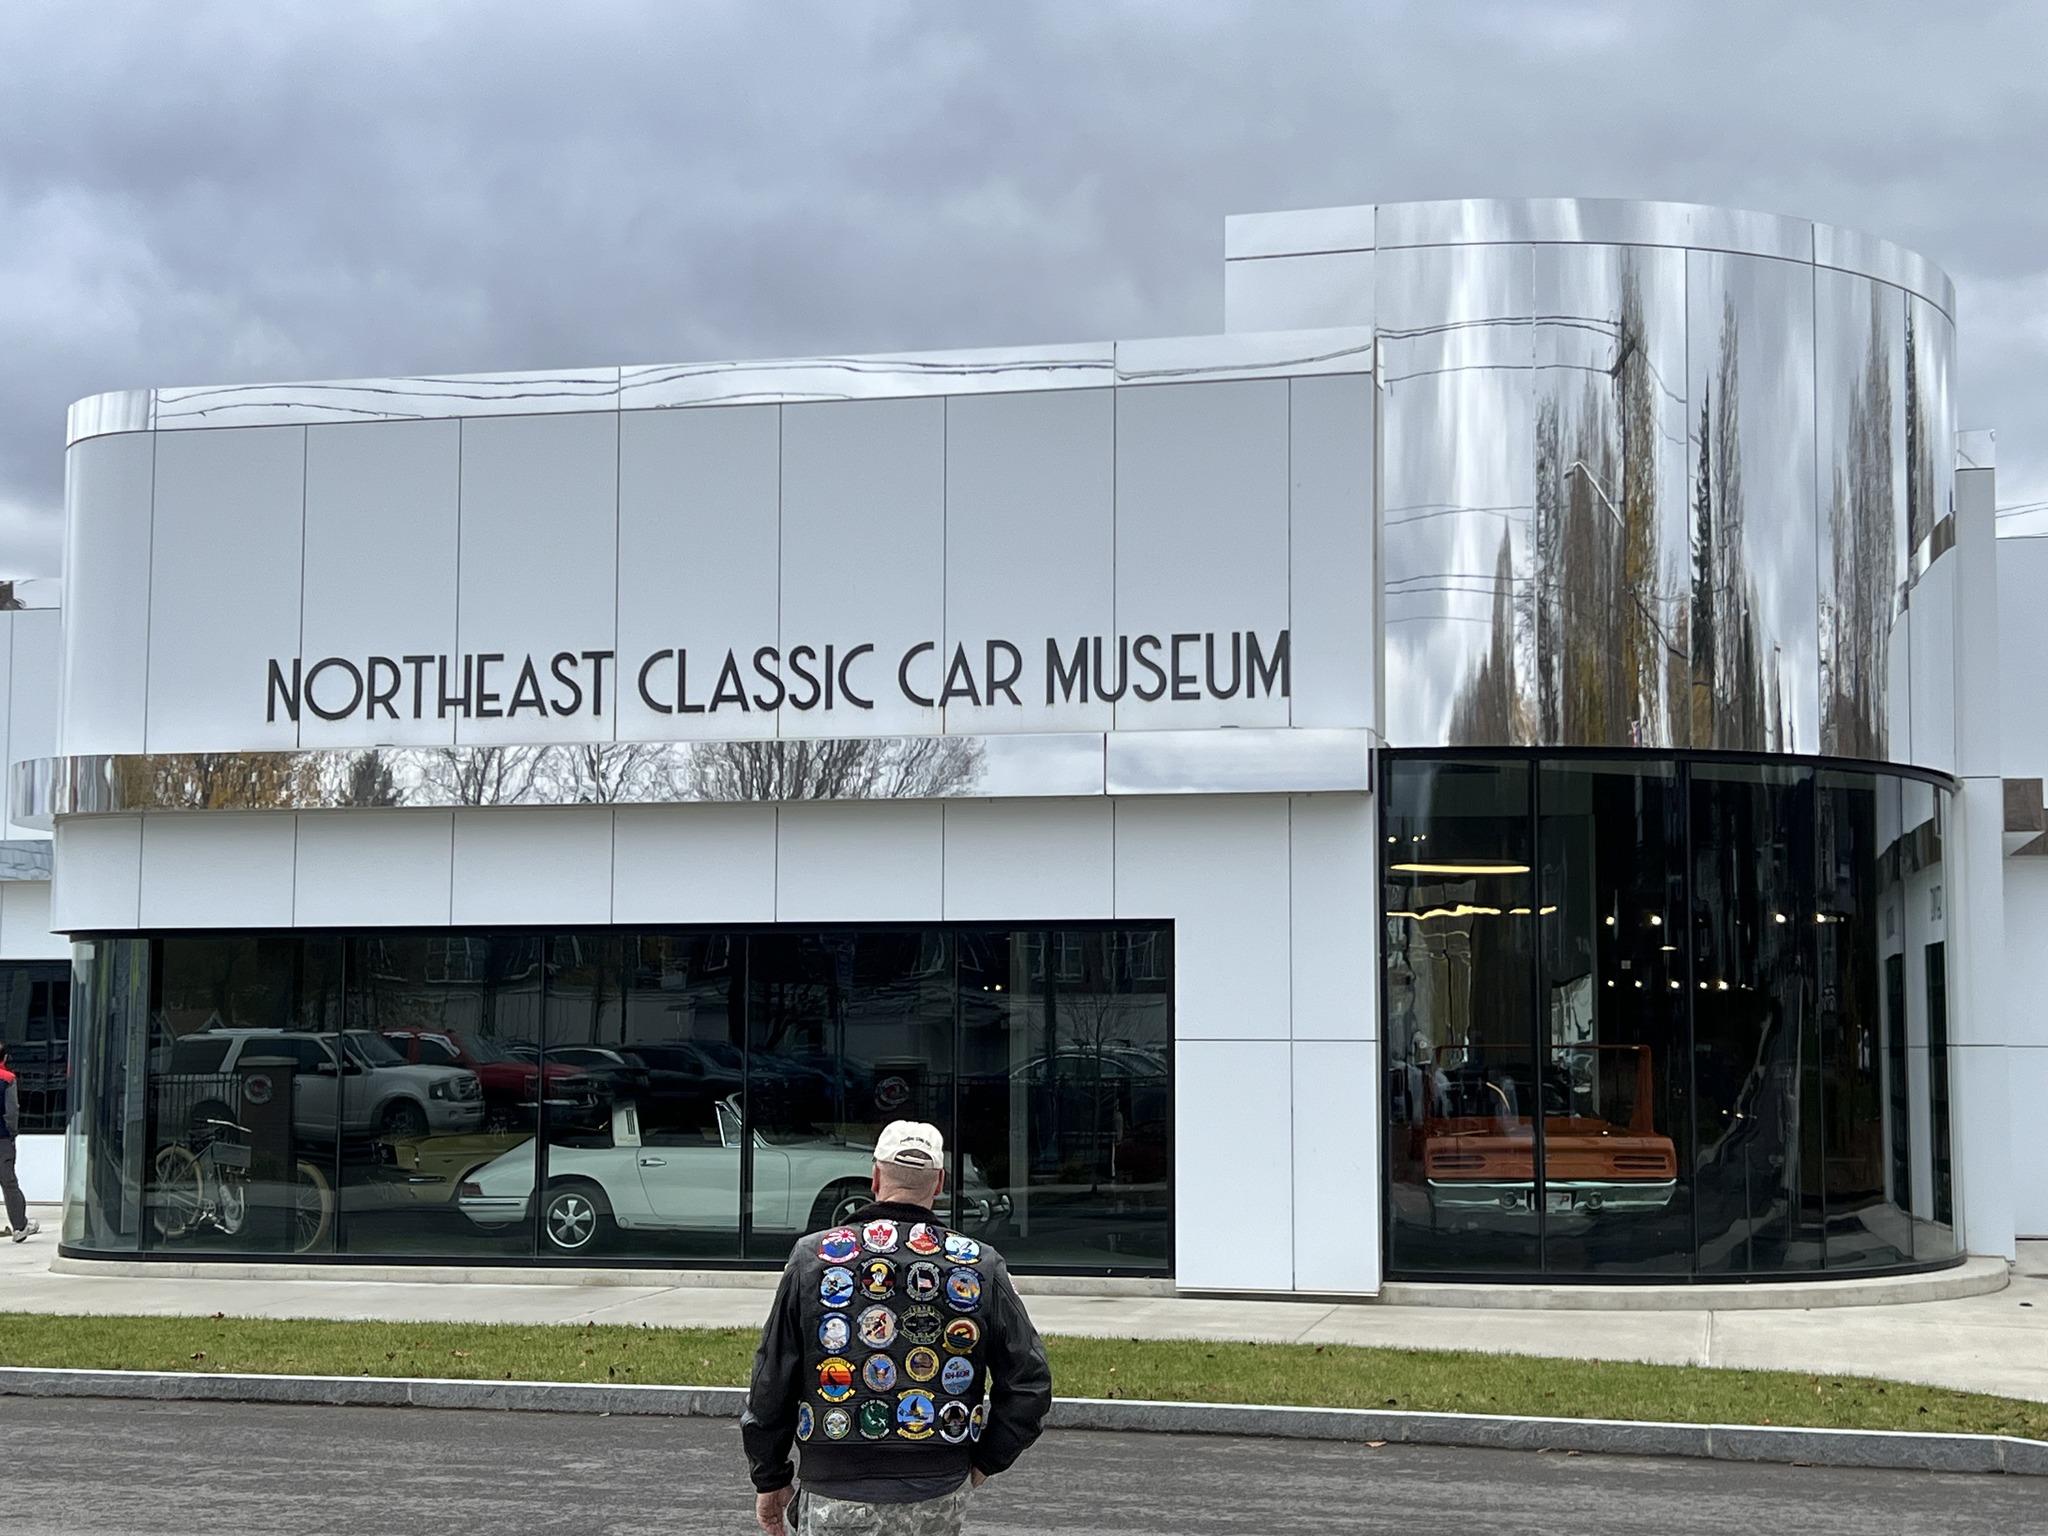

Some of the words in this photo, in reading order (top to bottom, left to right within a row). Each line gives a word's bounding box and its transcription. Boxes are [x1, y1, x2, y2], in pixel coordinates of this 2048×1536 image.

[267, 649, 614, 725] NORTHEAST
[639, 643, 873, 714] CLASSIC
[899, 639, 1021, 707] CAR
[1047, 631, 1290, 705] MUSEUM
